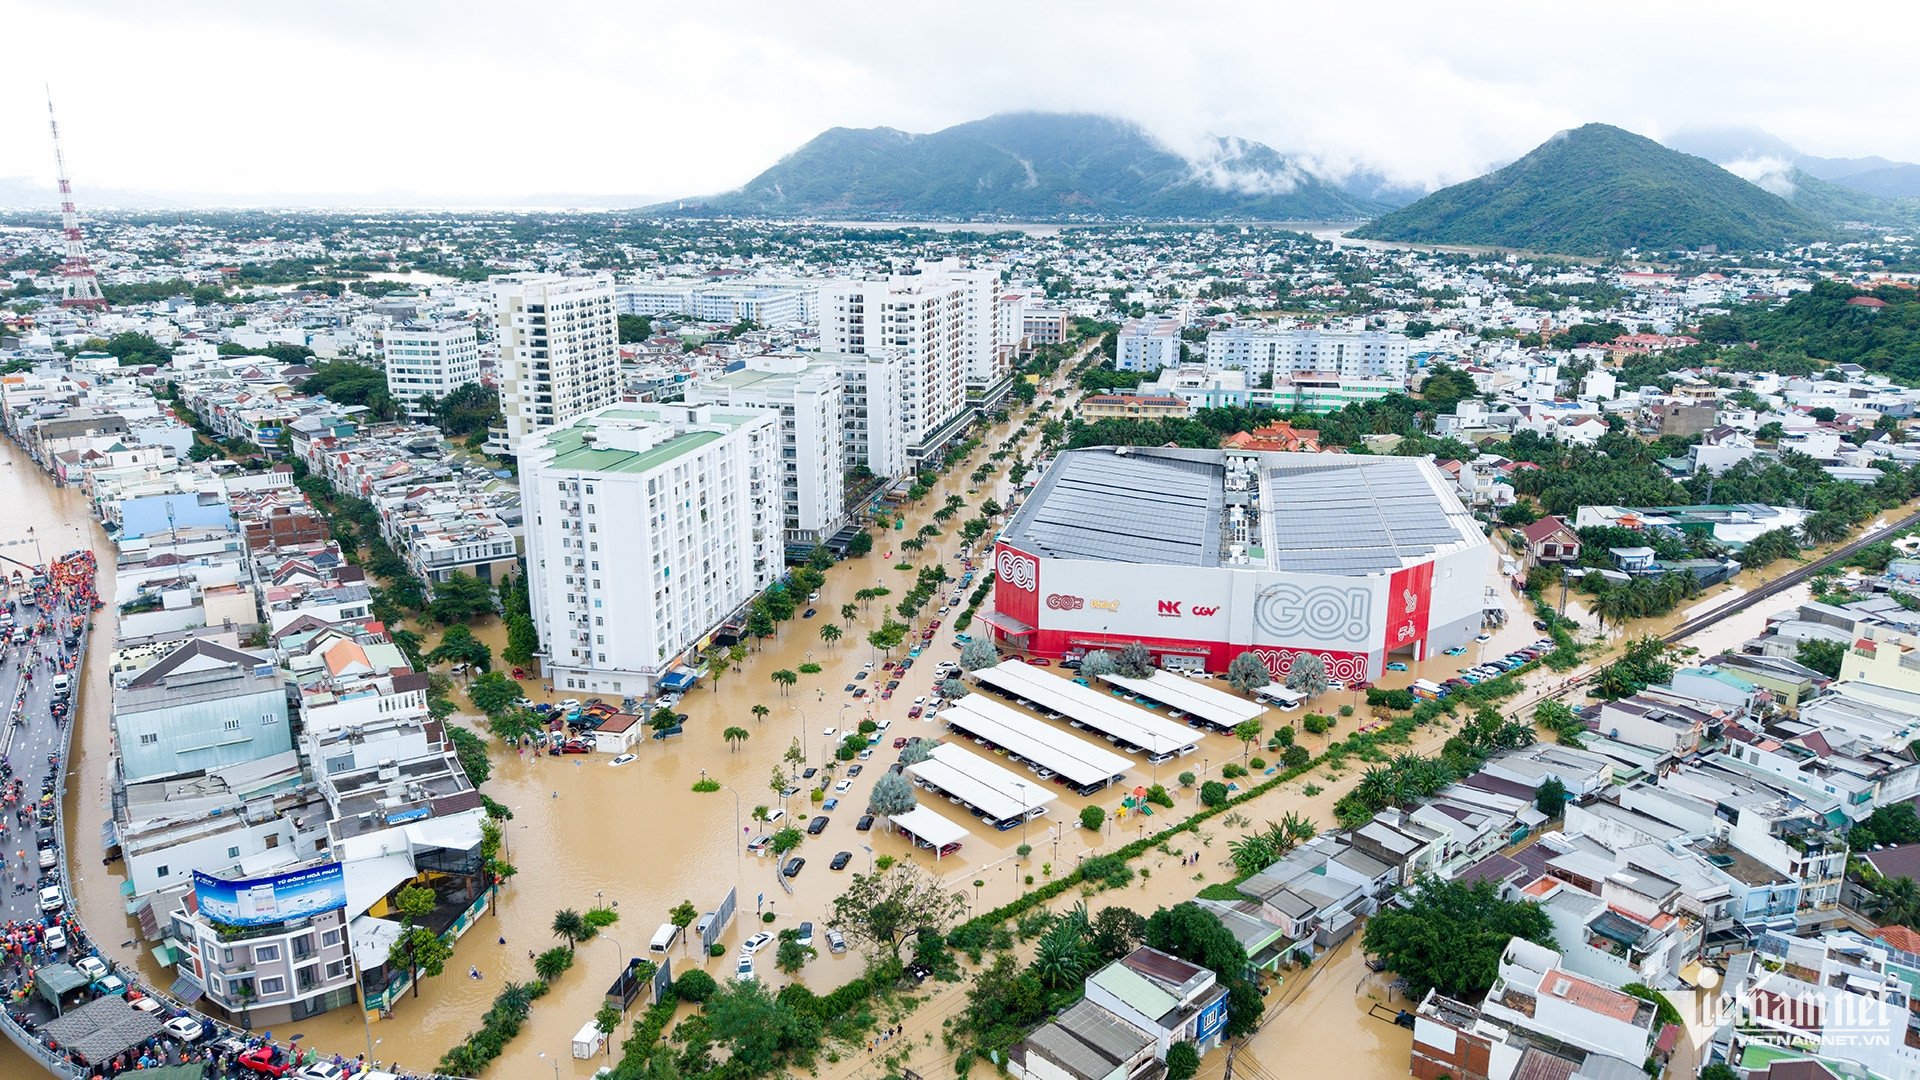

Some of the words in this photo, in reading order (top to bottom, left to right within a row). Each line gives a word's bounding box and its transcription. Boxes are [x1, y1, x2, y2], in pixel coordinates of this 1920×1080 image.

[997, 550, 1036, 592] GO!
[1158, 600, 1182, 614] NK
[1192, 605, 1217, 616] CGV
[1254, 582, 1372, 642] GO!
